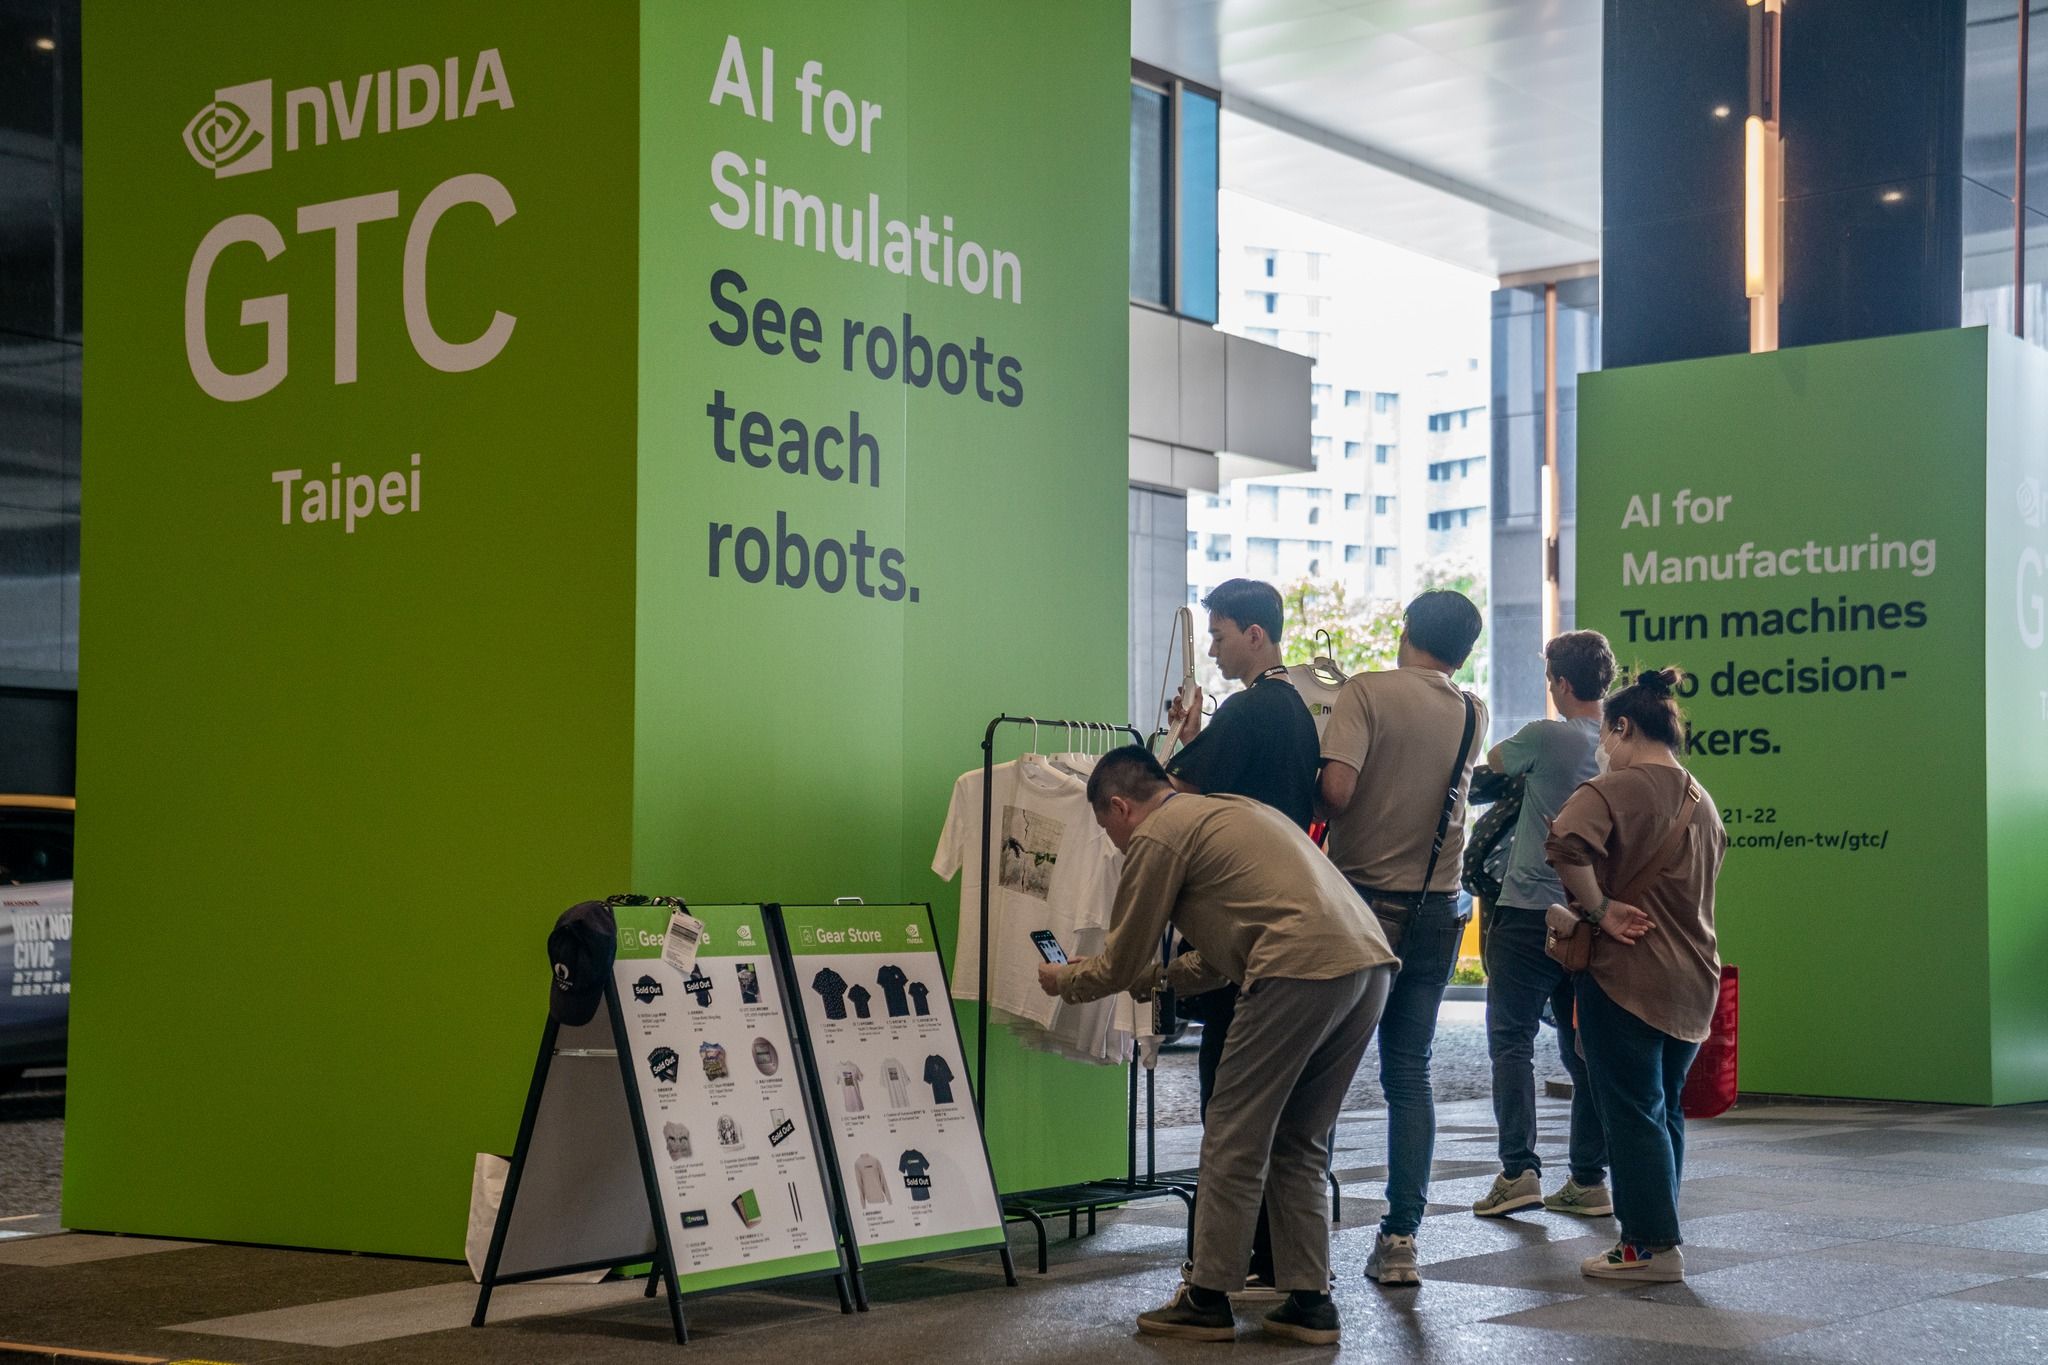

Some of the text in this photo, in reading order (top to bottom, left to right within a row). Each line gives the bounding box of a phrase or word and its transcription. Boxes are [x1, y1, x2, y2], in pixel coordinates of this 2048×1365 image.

[709, 34, 882, 154] AI for
[709, 150, 1022, 305] Simulation
[184, 172, 518, 403] GTC
[708, 268, 1024, 408] See robots
[706, 389, 880, 488] teach
[271, 453, 421, 534] Taipei
[1620, 488, 1733, 529] AI for
[708, 510, 920, 603] robots.
[1622, 532, 1937, 587] Manufacturing
[1619, 595, 1928, 643] Turn machines
[1710, 656, 1907, 697] decision-
[1685, 720, 1781, 756] kers.
[1722, 808, 1777, 824] 21-22
[1725, 830, 1889, 851] a.com/en-tw/gtc/
[12, 913, 47, 941] WHY
[638, 930, 665, 947] Gea
[816, 926, 883, 944] Gear Store
[14, 940, 55, 969] CIVIC
[635, 985, 661, 995] Sold Out
[686, 980, 711, 992] Sold Out
[906, 1178, 929, 1186] Sold Out
